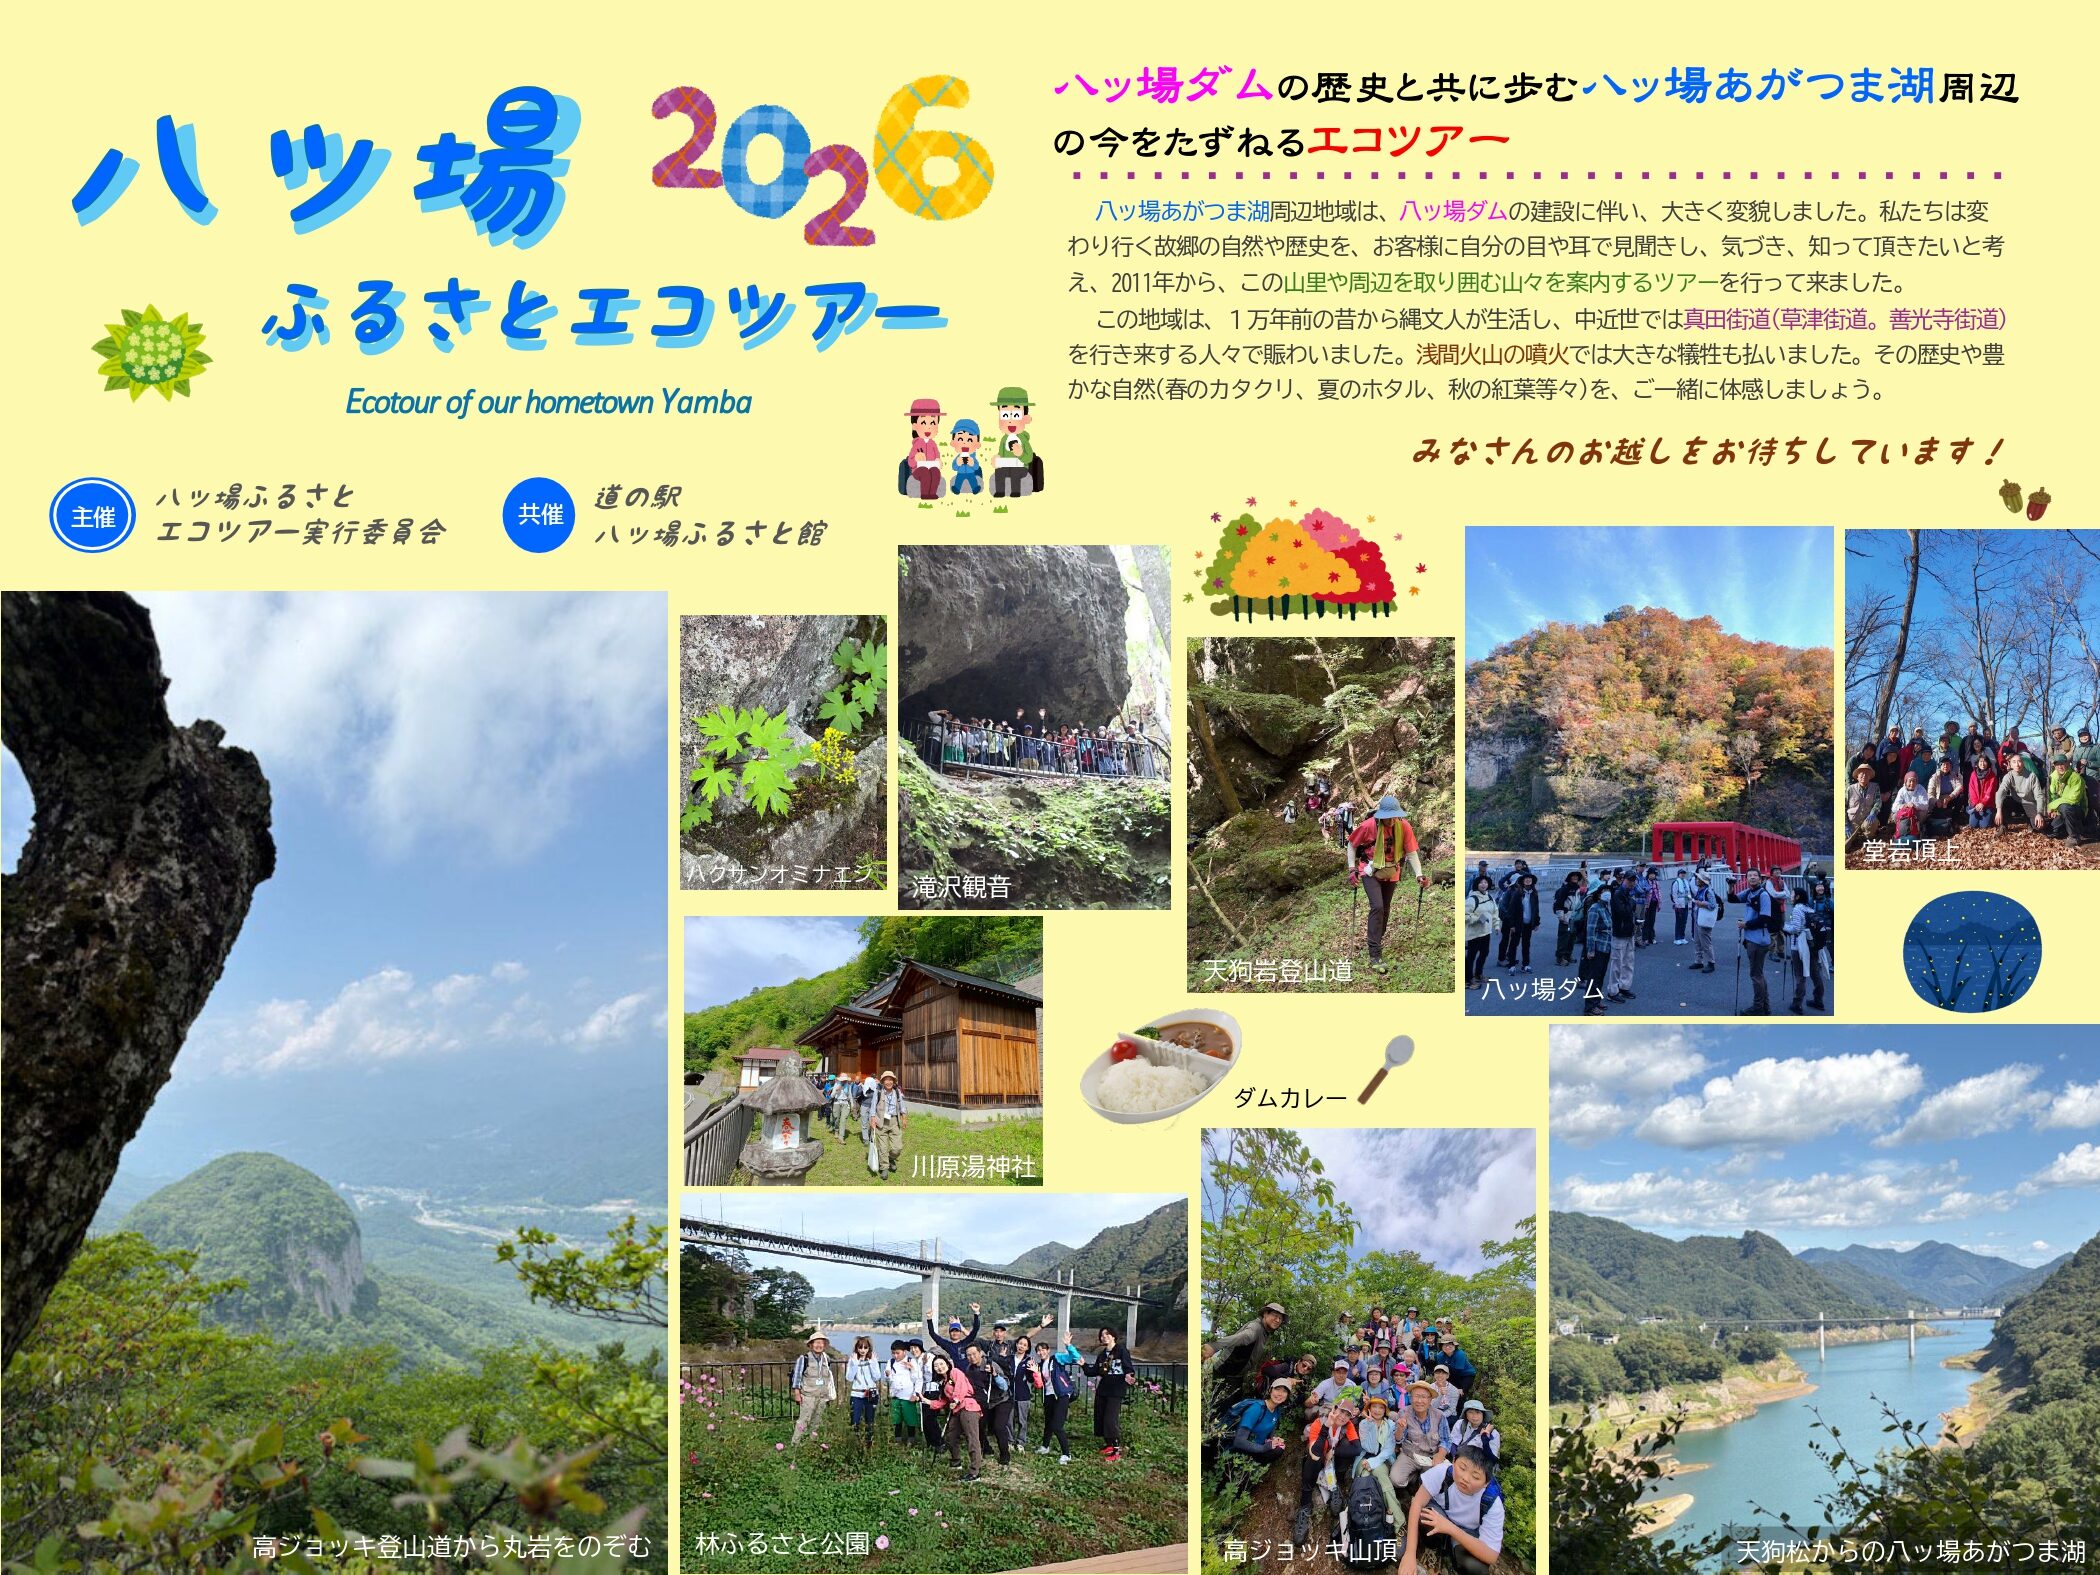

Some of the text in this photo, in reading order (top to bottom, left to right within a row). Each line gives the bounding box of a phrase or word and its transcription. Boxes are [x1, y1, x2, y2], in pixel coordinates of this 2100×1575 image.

[1054, 125, 1510, 158] の今をたずねるエコツアー
[652, 75, 994, 247] 2026
[261, 277, 948, 355] ふるさとエコツアー
[346, 387, 753, 420] Ecotour of our hometown Yamba
[594, 483, 683, 510] 道の駅
[71, 505, 116, 529] 主催
[518, 502, 565, 526] 共催
[156, 517, 448, 546] エコツアー実行委員会
[1234, 1086, 1347, 1109] ダムカレー
